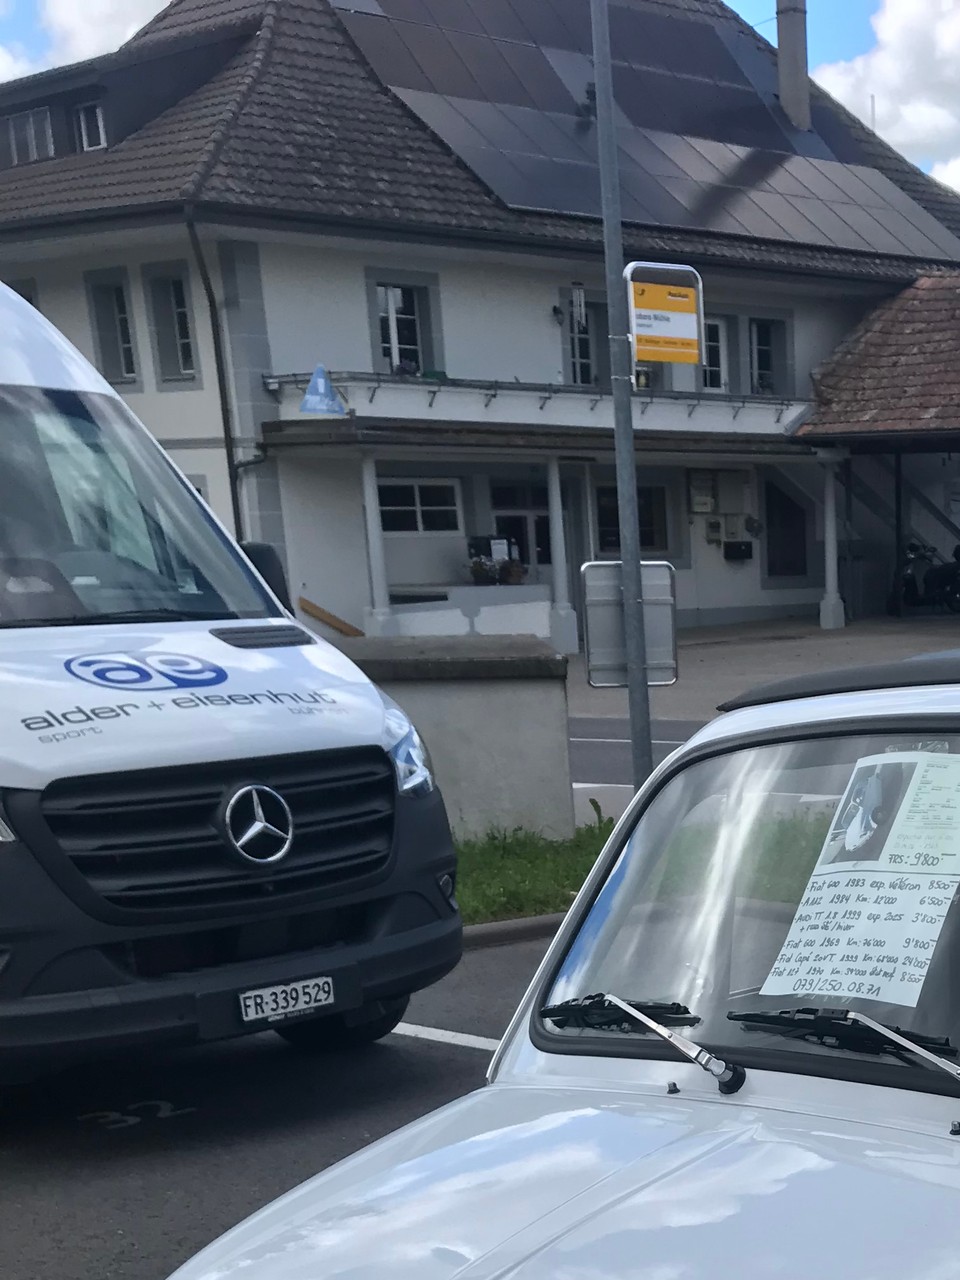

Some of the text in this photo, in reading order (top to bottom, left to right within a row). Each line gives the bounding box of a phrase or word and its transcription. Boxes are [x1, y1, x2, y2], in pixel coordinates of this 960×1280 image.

[20, 705, 140, 731] alder
[171, 689, 337, 709] eisenhut
[38, 726, 103, 744] sport
[829, 893, 851, 904] 1984
[819, 937, 840, 947] 1969
